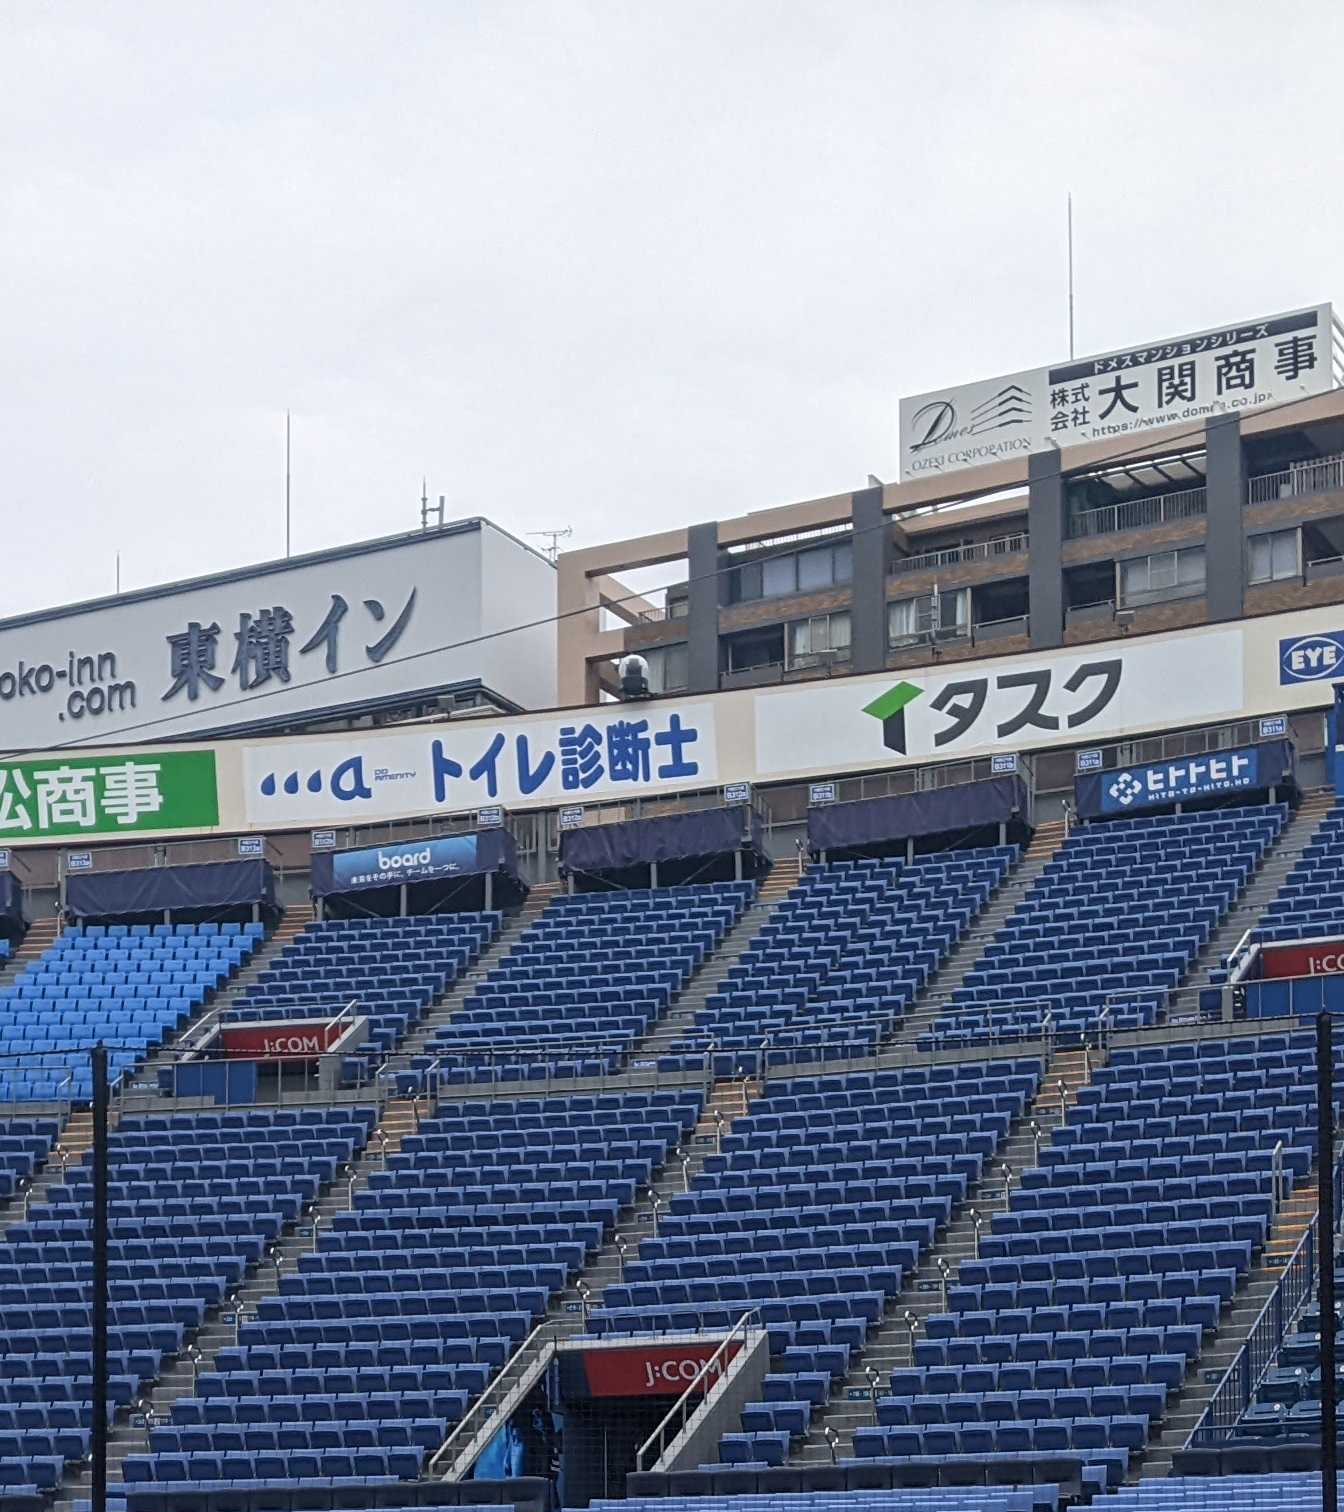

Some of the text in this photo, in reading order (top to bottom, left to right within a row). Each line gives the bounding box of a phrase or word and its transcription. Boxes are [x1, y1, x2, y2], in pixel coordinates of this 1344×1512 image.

[1093, 323, 1269, 374] ドメスマンションシリーズ
[1098, 334, 1317, 420] 大関商事
[1049, 383, 1091, 409] 株式
[1050, 406, 1091, 432] 会社
[948, 437, 1032, 463] CORPORATION
[161, 585, 417, 702] 東横イン
[1291, 645, 1338, 671] EYE
[58, 678, 136, 721] .com
[930, 659, 1123, 748] タスク
[430, 714, 700, 802] トイレ診断士
[1147, 755, 1249, 790] ヒトトヒト
[378, 848, 431, 870] board
[263, 1036, 320, 1052] J:COM
[645, 1358, 722, 1387] J:COM
